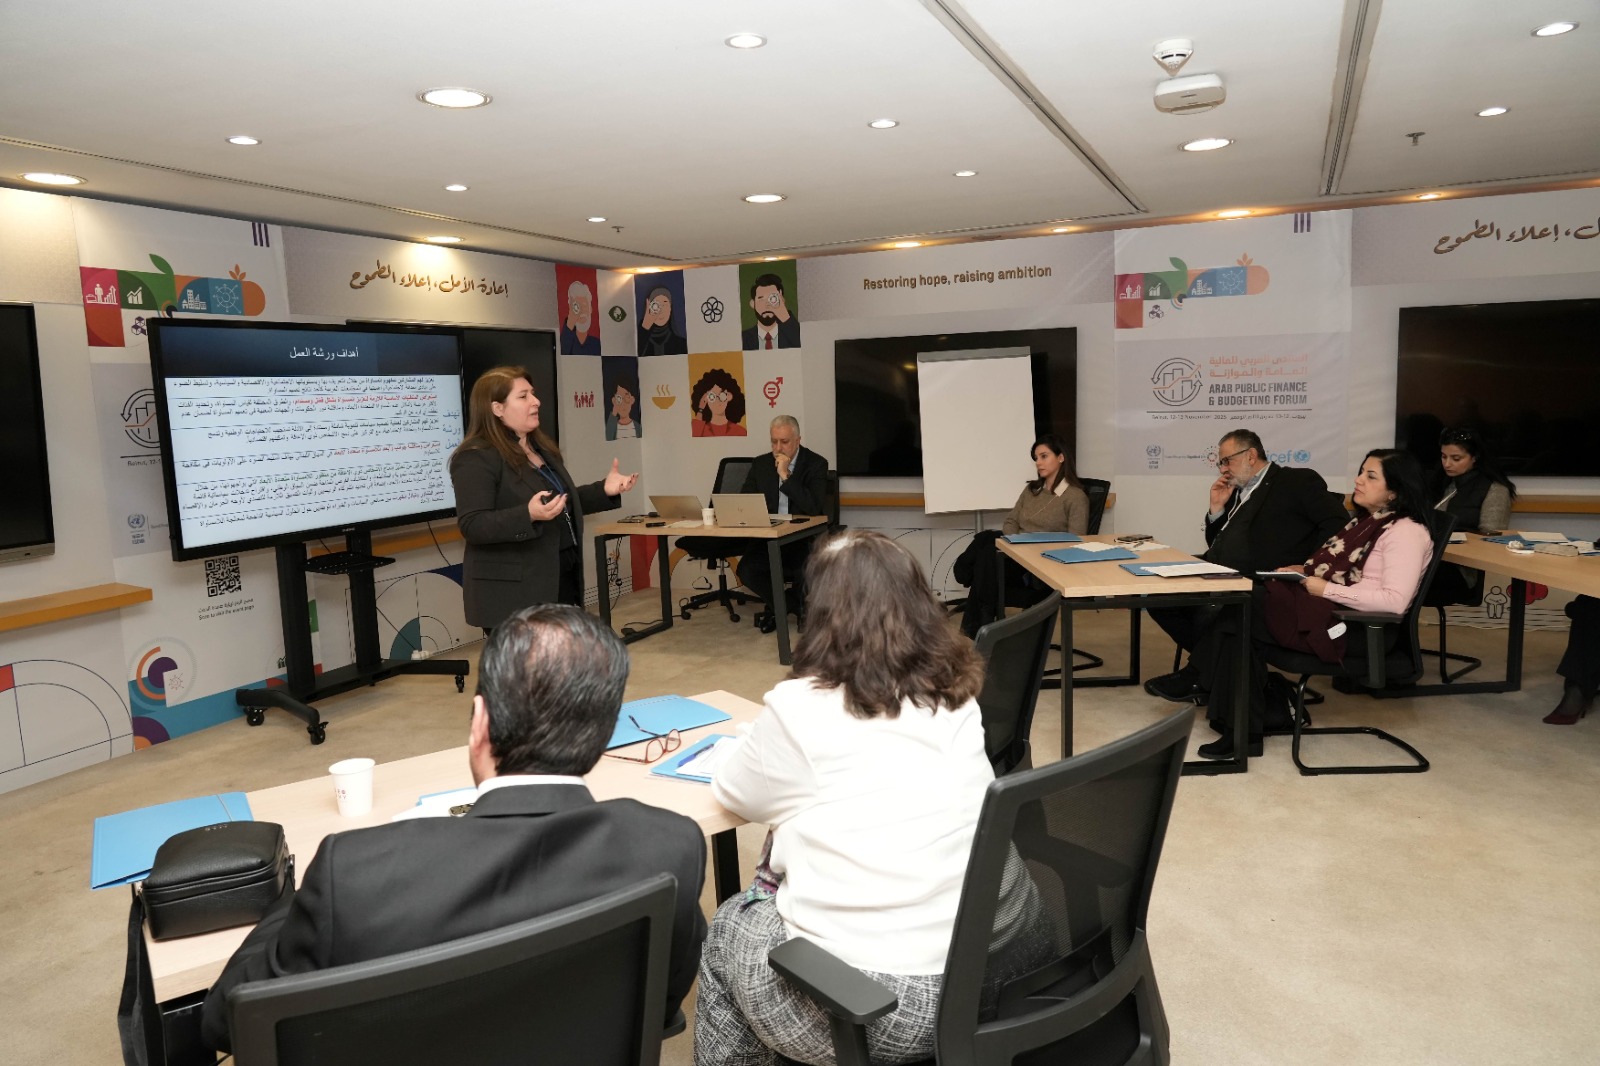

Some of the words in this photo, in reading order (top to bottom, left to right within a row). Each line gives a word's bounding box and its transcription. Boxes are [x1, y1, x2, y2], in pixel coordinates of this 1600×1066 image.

[1434, 218, 1500, 254] الطموح
[1506, 224, 1559, 242] إعلاء
[350, 259, 396, 290] الطموح
[864, 276, 916, 290] Restoring
[919, 274, 950, 288] hope,
[954, 270, 994, 284] raising
[998, 266, 1052, 280] ambition
[399, 273, 431, 292] إعلاء
[477, 278, 508, 298] إعادة
[290, 346, 310, 358] العمل
[312, 347, 335, 360] ورشة
[336, 346, 359, 358] أهداف
[1210, 356, 1238, 367] للمالية
[1209, 384, 1232, 394] ARAB
[1235, 382, 1266, 393] PUBLIC
[1268, 382, 1308, 392] FINANCE
[1209, 396, 1214, 405] &
[1217, 395, 1271, 405] BUDGETING
[1274, 394, 1307, 405] FORUM
